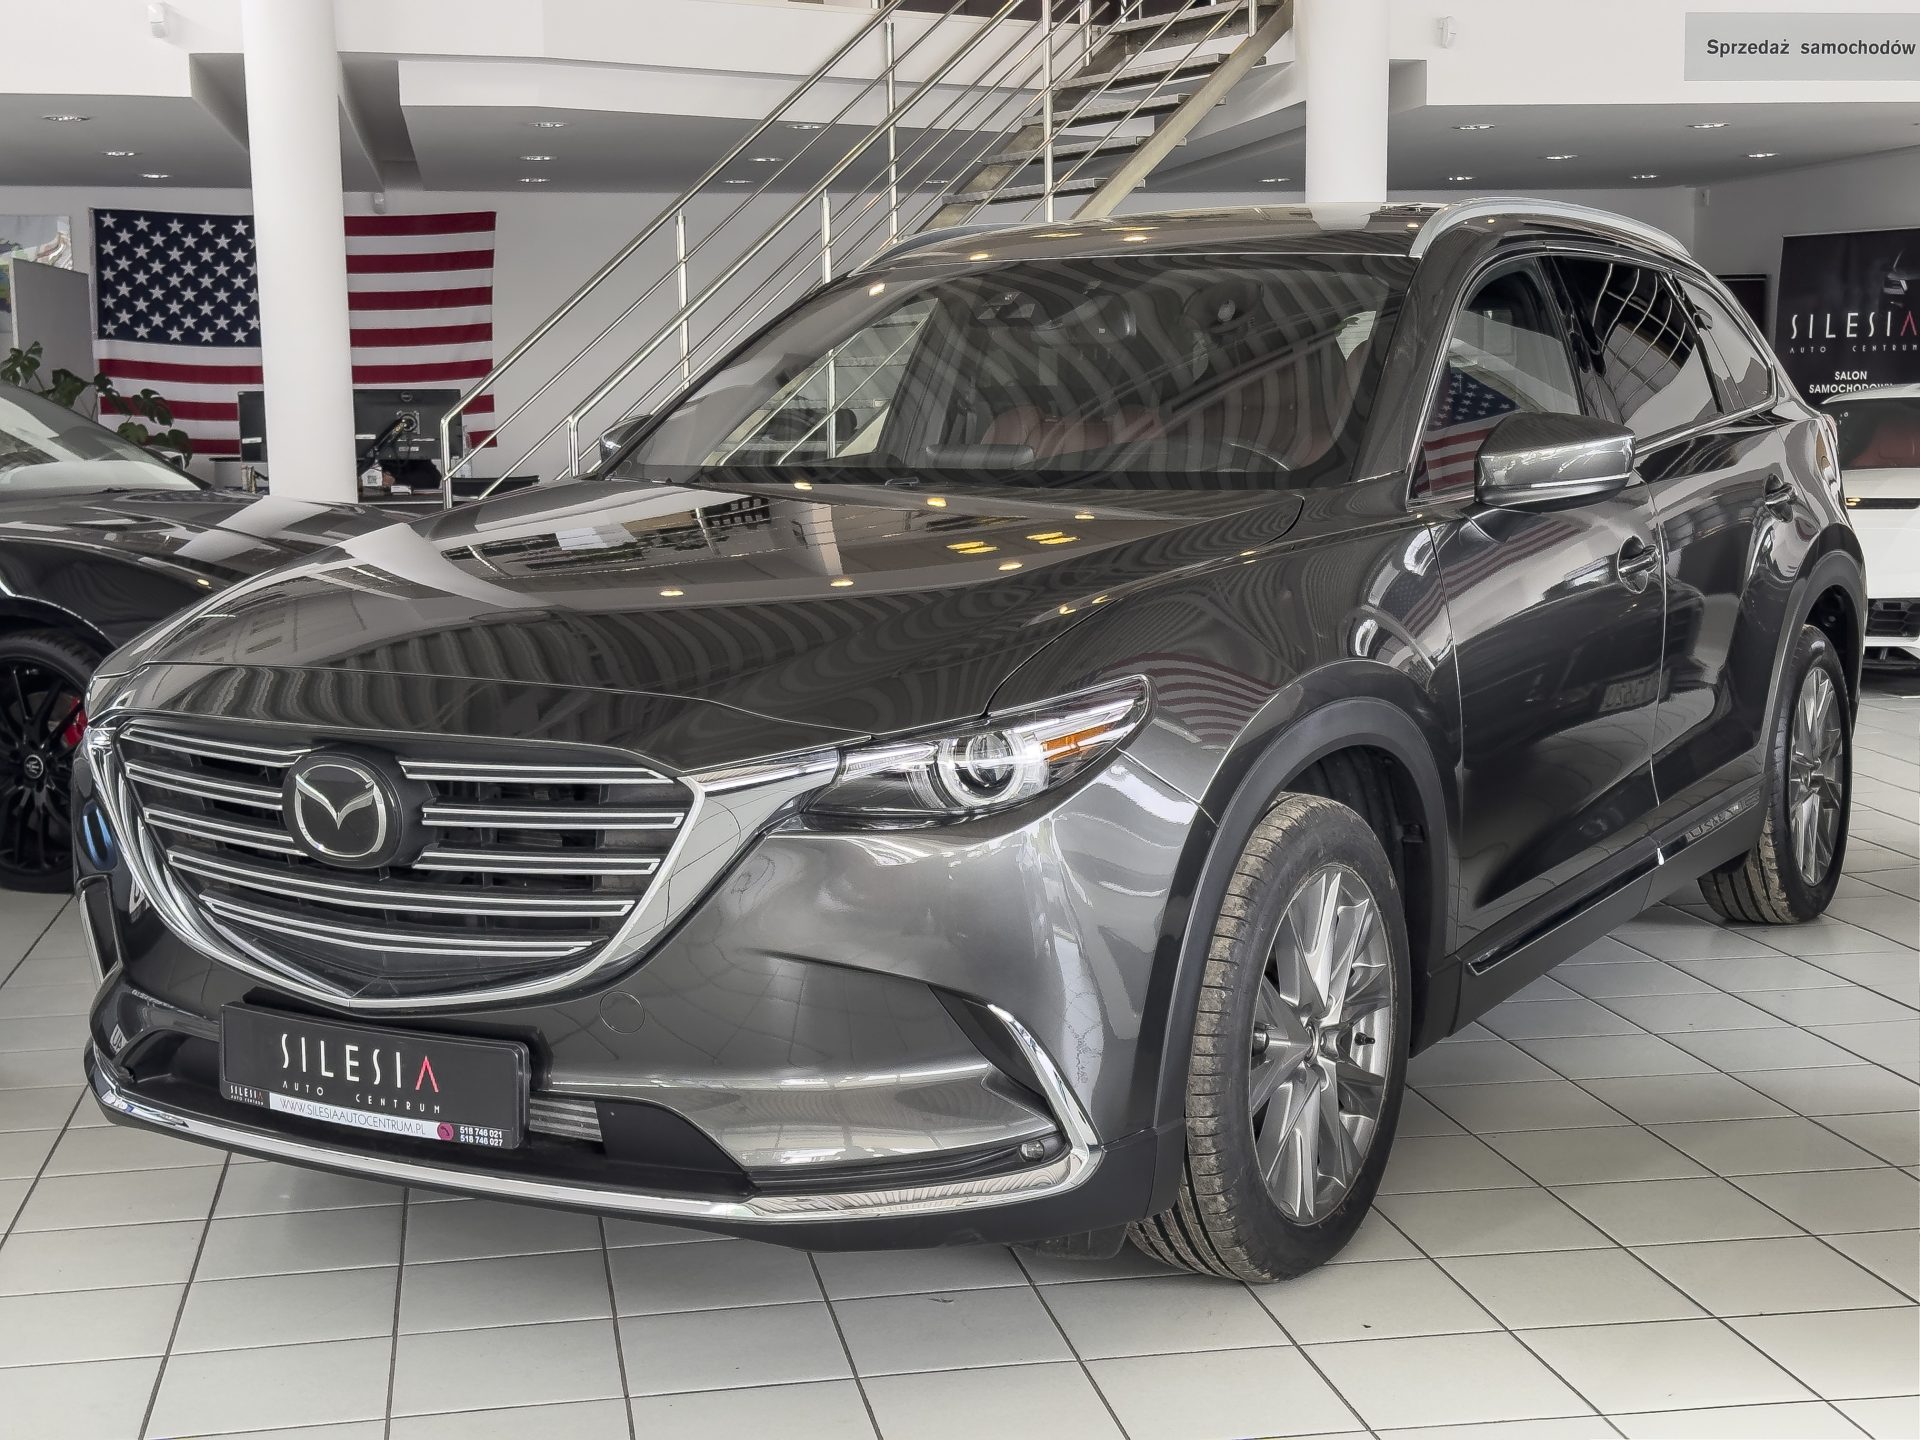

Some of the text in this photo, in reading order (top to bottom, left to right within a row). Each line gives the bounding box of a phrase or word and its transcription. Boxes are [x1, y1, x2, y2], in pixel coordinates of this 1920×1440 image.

[1706, 38, 1917, 58] Sprzedaż samochodów
[1790, 310, 1918, 340] SILESIA
[1789, 343, 1918, 354] AUTO CENTRUM
[1834, 370, 1868, 381] SALON
[1808, 383, 1893, 394] SAMOCHODO
[281, 1033, 440, 1094] SILESIA
[230, 1084, 264, 1100] SILESIA
[282, 1080, 441, 1115] AUTO CENTRUM
[279, 1098, 426, 1136] WWW.SILESIAAUTOCENTRUM.PL
[459, 1126, 473, 1135] 518
[489, 1130, 502, 1139] 021
[460, 1134, 474, 1143] 518
[489, 1138, 503, 1147] 027
